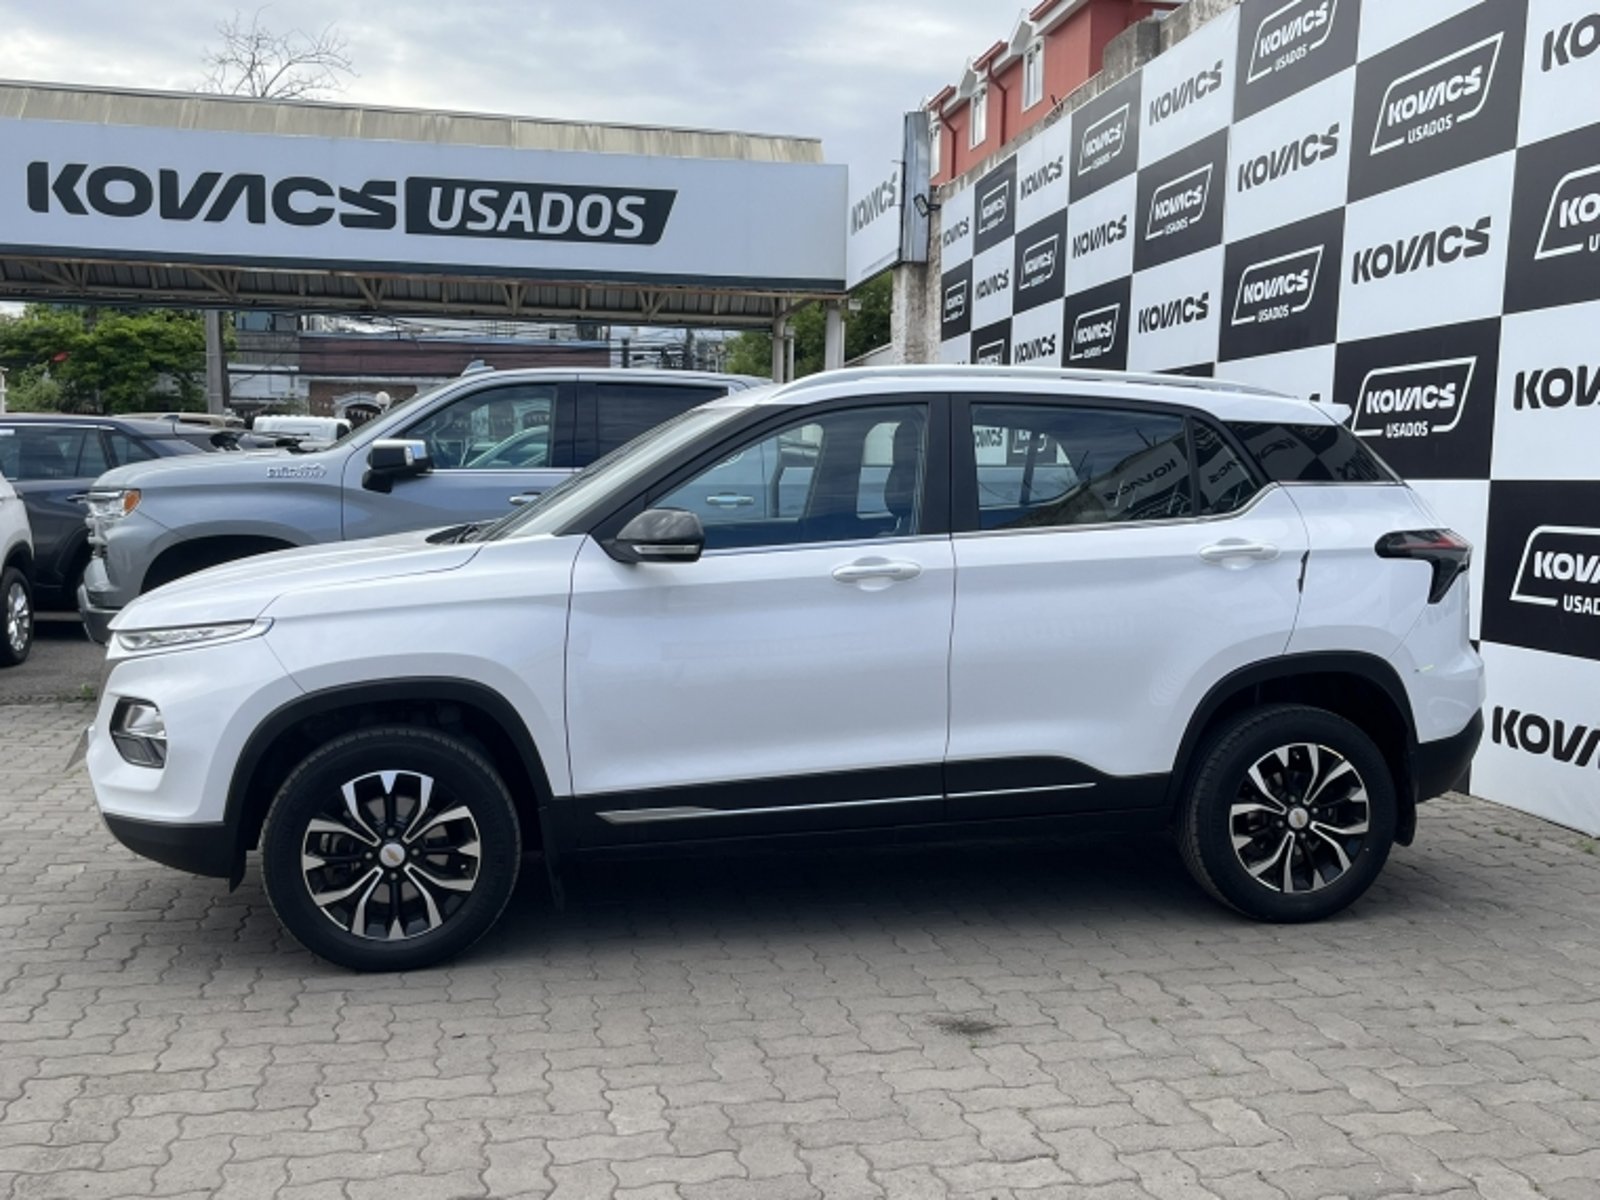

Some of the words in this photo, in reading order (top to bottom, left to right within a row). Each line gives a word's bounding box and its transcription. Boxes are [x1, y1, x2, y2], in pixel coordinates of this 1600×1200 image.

[1260, 2, 1328, 57] KOVACS
[1275, 43, 1307, 71] USADOS
[1149, 60, 1223, 126] KOVACS
[1387, 65, 1482, 126] KOVACS
[1407, 115, 1453, 144] USADOS
[1238, 122, 1340, 192] KOVACS
[27, 160, 397, 230] KOVACS
[427, 185, 646, 239] USADOS
[1155, 185, 1203, 220] KOVACS
[1073, 214, 1127, 259] KOVACS
[1352, 216, 1491, 285] KOVACS
[1243, 270, 1309, 304] KOVACS
[1138, 291, 1209, 334] KOVACS
[1258, 305, 1289, 323] USADOS
[1366, 382, 1456, 414] KOVACS
[1386, 421, 1428, 438] USADOS
